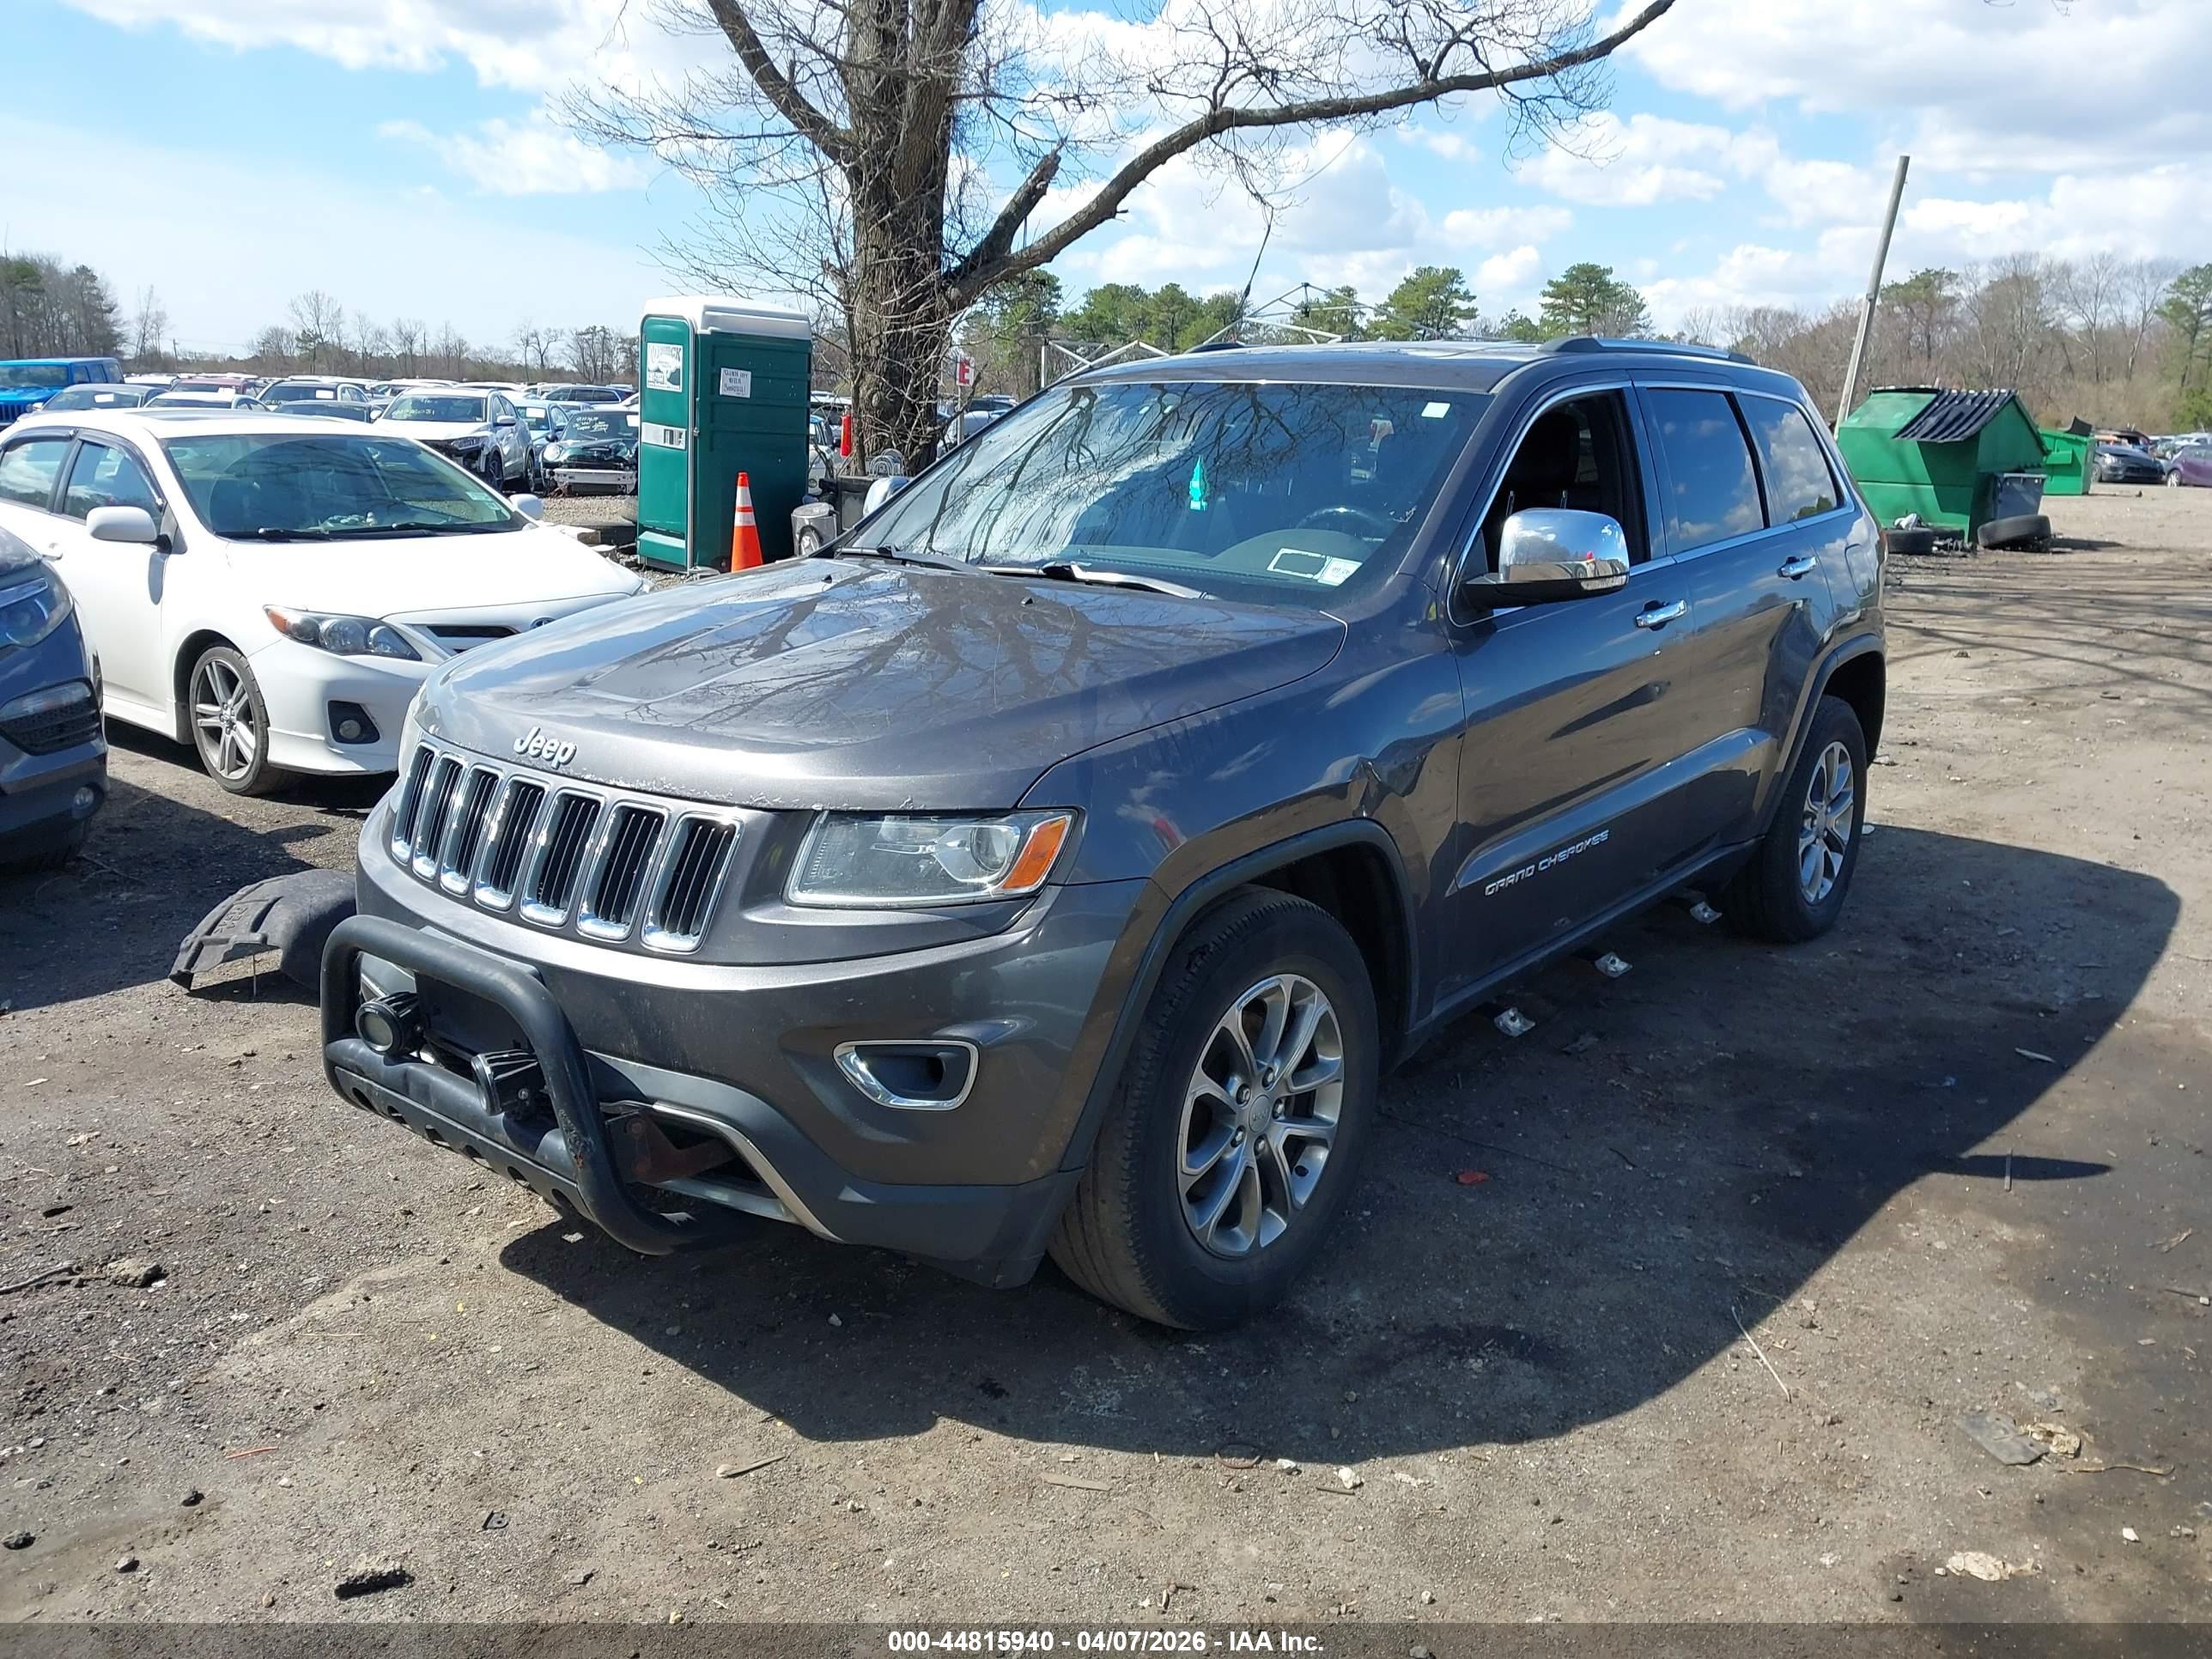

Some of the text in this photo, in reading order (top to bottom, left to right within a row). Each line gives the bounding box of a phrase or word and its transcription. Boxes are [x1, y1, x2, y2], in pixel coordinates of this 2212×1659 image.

[514, 726, 577, 770] Jeep
[1485, 830, 1609, 896] GRAND CHEROKEE
